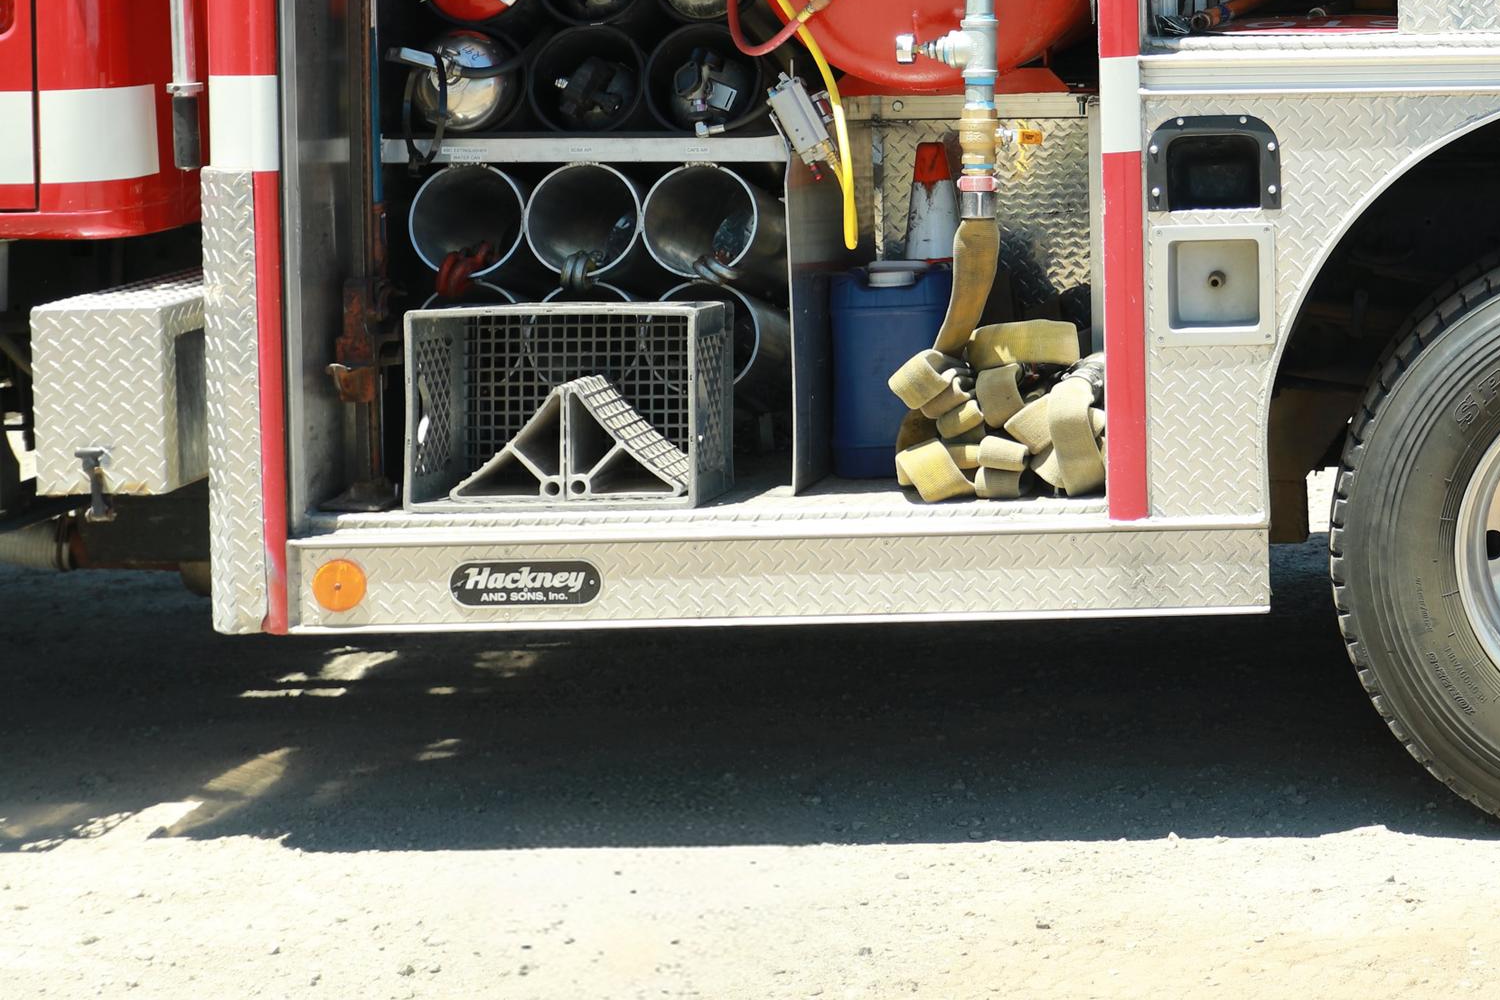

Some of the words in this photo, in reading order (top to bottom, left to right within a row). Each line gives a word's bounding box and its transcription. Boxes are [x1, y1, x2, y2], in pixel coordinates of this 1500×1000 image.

[464, 566, 586, 593] Hackney
[480, 592, 507, 602] AND
[509, 591, 547, 602] SONS,
[548, 591, 568, 601] Inc.
